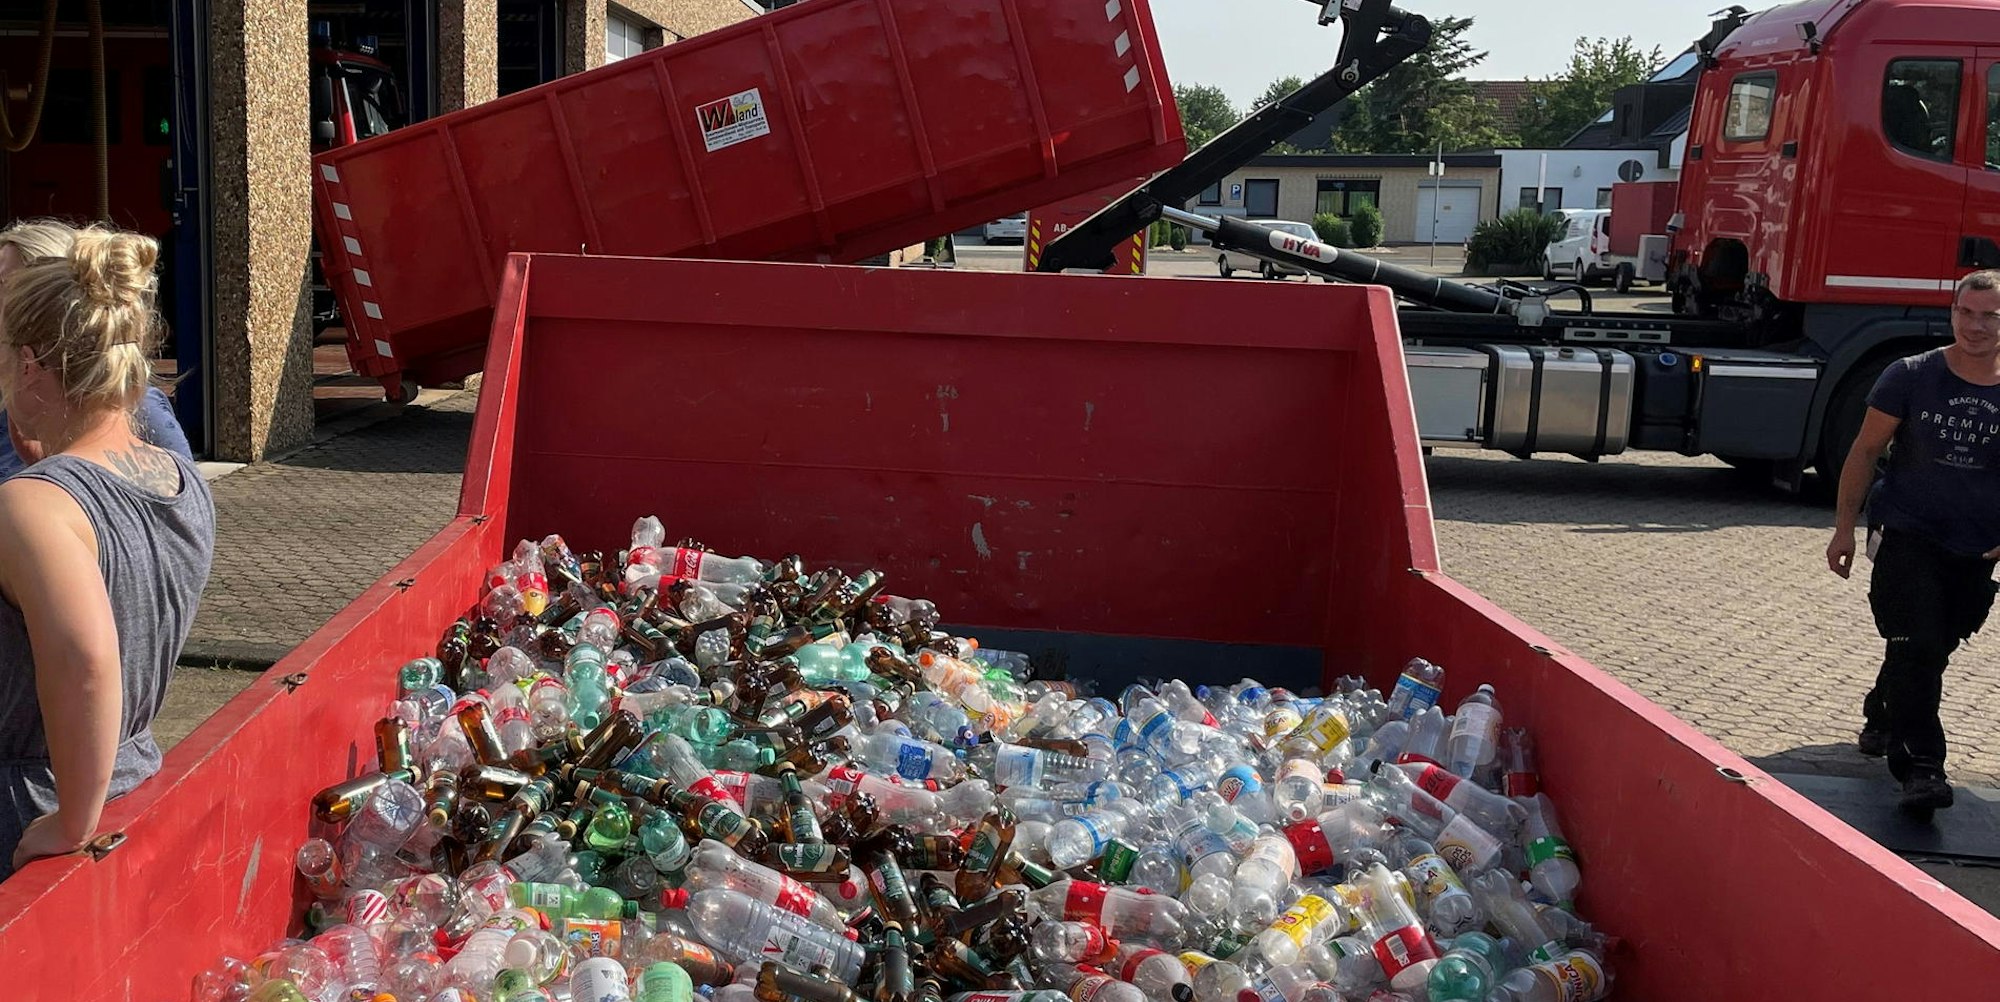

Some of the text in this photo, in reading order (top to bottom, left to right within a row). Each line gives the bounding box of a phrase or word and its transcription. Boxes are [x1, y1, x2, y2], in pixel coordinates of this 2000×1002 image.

[1232, 185, 1241, 195] P
[1053, 223, 1071, 233] AB-
[1283, 237, 1320, 258] HYVA
[1948, 397, 1979, 406] BEACH
[1980, 400, 1999, 414] TIME
[1921, 411, 2000, 434] PREMIU
[1940, 429, 1991, 445] SURF
